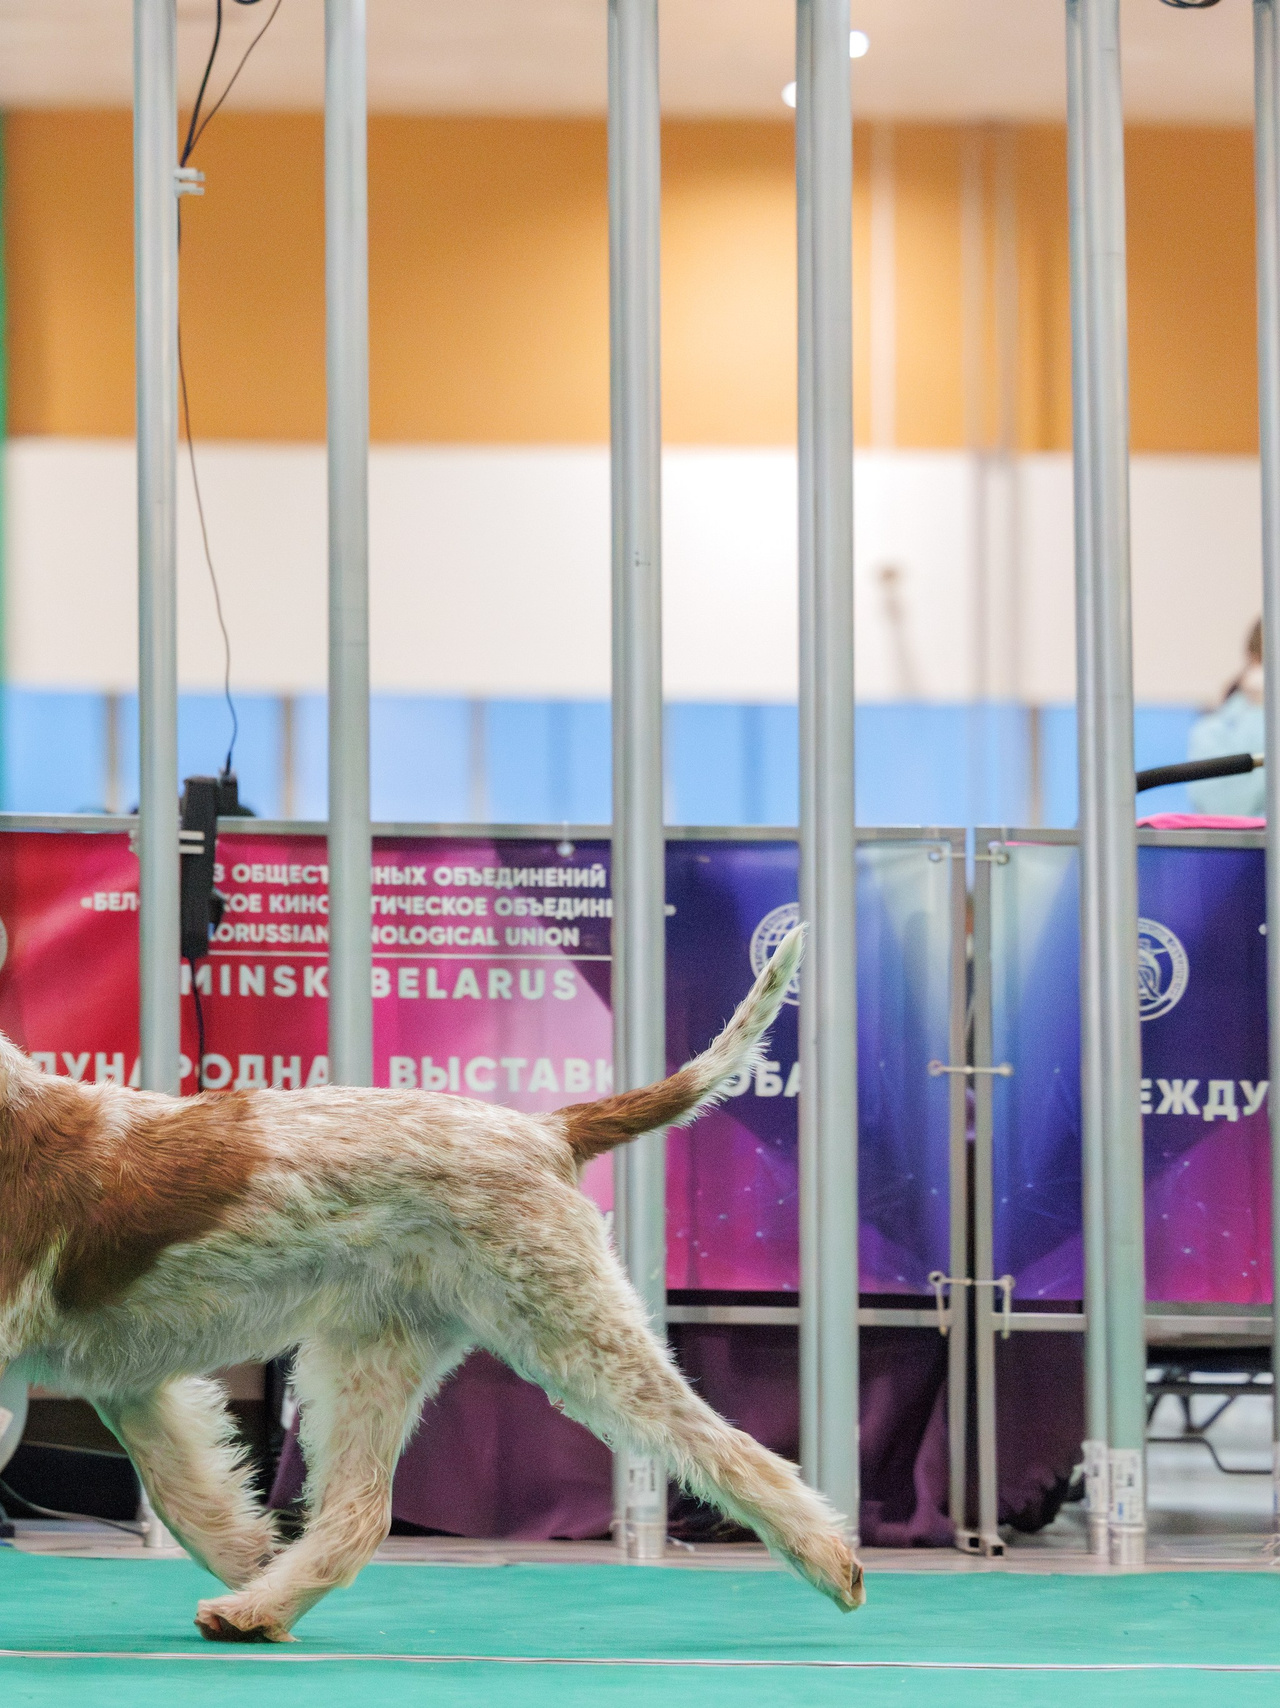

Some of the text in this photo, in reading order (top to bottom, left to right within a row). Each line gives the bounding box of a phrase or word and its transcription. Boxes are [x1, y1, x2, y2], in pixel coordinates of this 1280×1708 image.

[232, 863, 427, 886] ОБЩЕСТНЫХ
[433, 863, 606, 890] ОБЪЕДИНЕНИЙ
[270, 894, 487, 916] КИНОГИЧЕСКОЕ
[505, 927, 580, 947] UNION
[181, 964, 577, 1000] MINSK BELARUS
[389, 1055, 613, 1093] ВЫСТАВК
